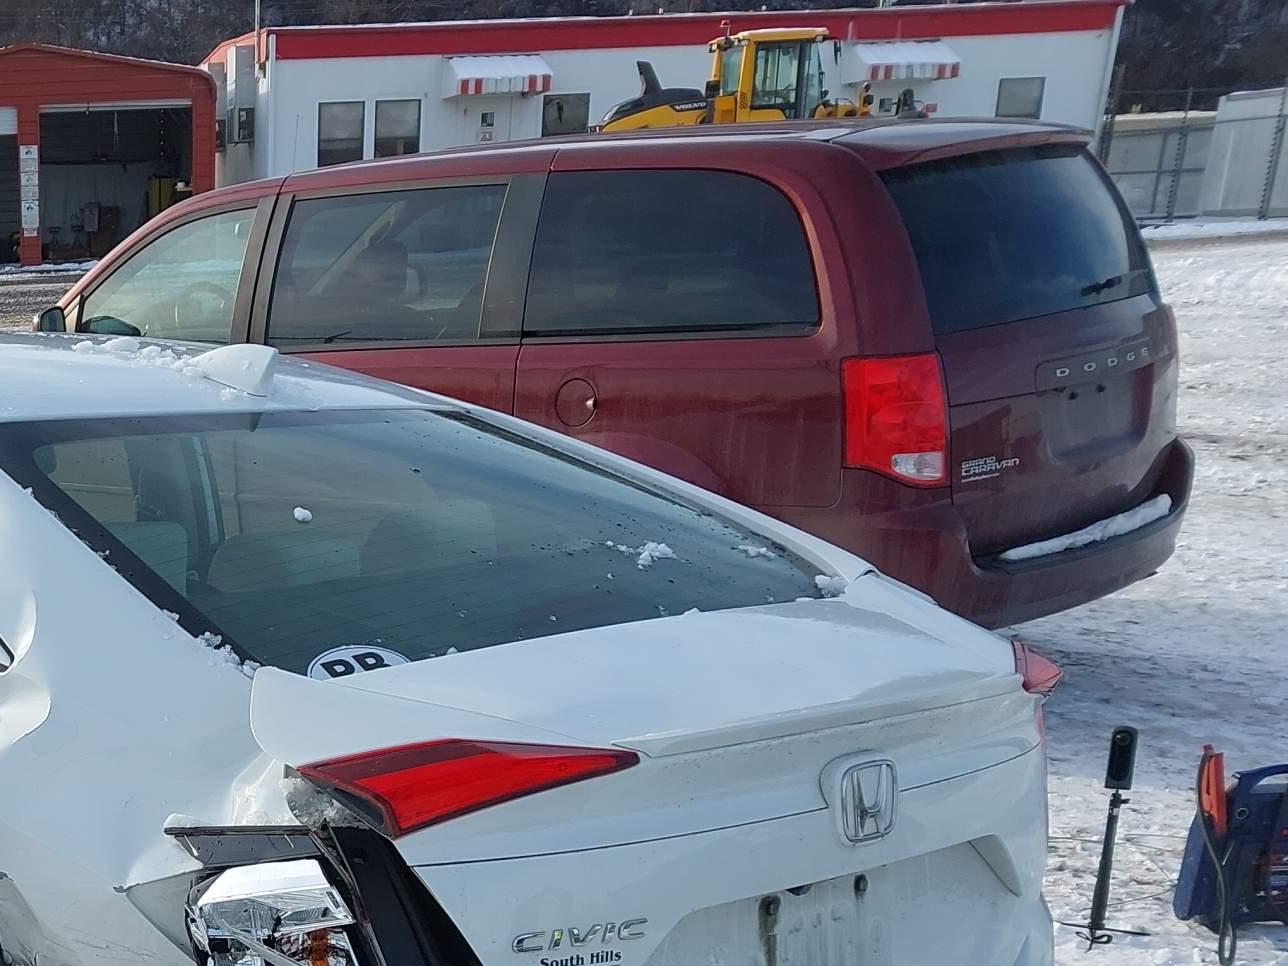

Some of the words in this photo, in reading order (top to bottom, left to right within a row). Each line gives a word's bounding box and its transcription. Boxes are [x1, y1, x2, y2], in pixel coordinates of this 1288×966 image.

[675, 102, 707, 110] VOLVO
[1056, 345, 1149, 377] DODGE
[961, 458, 1020, 476] CARAVAN
[962, 456, 996, 469] GRAND
[512, 917, 648, 953] CIVIC
[590, 949, 622, 965] Hills
